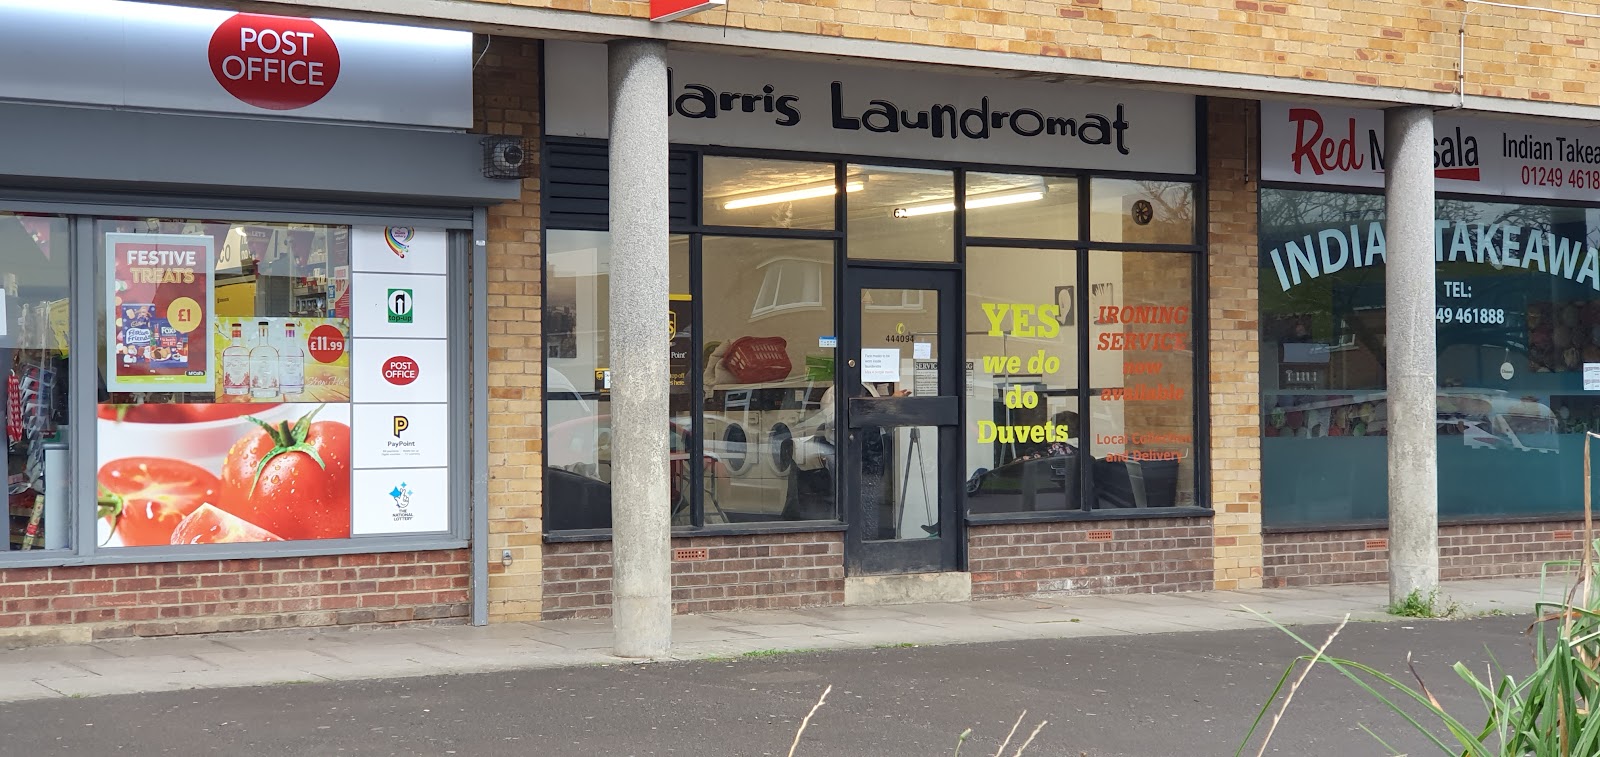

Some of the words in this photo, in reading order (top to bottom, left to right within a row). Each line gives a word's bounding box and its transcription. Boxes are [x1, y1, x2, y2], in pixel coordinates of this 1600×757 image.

[240, 27, 315, 56] POST
[221, 55, 325, 86] OFFICE
[830, 81, 1130, 156] Laundromat
[1289, 108, 1364, 176] Red
[1368, 127, 1479, 170] Msala
[1503, 132, 1552, 161] Indian
[1521, 165, 1563, 187] 01249
[1568, 169, 1600, 190] 4618
[126, 249, 197, 266] FESTIVE
[1269, 220, 1387, 292] INDIA
[129, 267, 195, 284] TREATS
[1443, 281, 1472, 298] TEL:
[177, 308, 191, 322] £1
[388, 315, 412, 323] top-up
[981, 303, 1060, 338] YES
[1097, 305, 1189, 325] IRONING
[1455, 308, 1505, 325] 461888
[310, 336, 343, 351] £11.99
[885, 334, 915, 343] 444094
[1096, 332, 1188, 351] SERVICE
[390, 361, 412, 370] POST
[915, 362, 938, 370] SERVIC
[983, 354, 1020, 374] we
[1028, 349, 1060, 374] do
[1122, 361, 1163, 375] now
[385, 370, 416, 379] OFFICE
[1005, 384, 1039, 409] do
[1100, 384, 1184, 401] available
[977, 420, 1069, 444] Duvets
[1096, 434, 1128, 445] Local
[1131, 432, 1192, 445] Collection
[387, 440, 416, 448] PayPoint
[1105, 450, 1129, 463] and
[1132, 450, 1183, 463] Delivery
